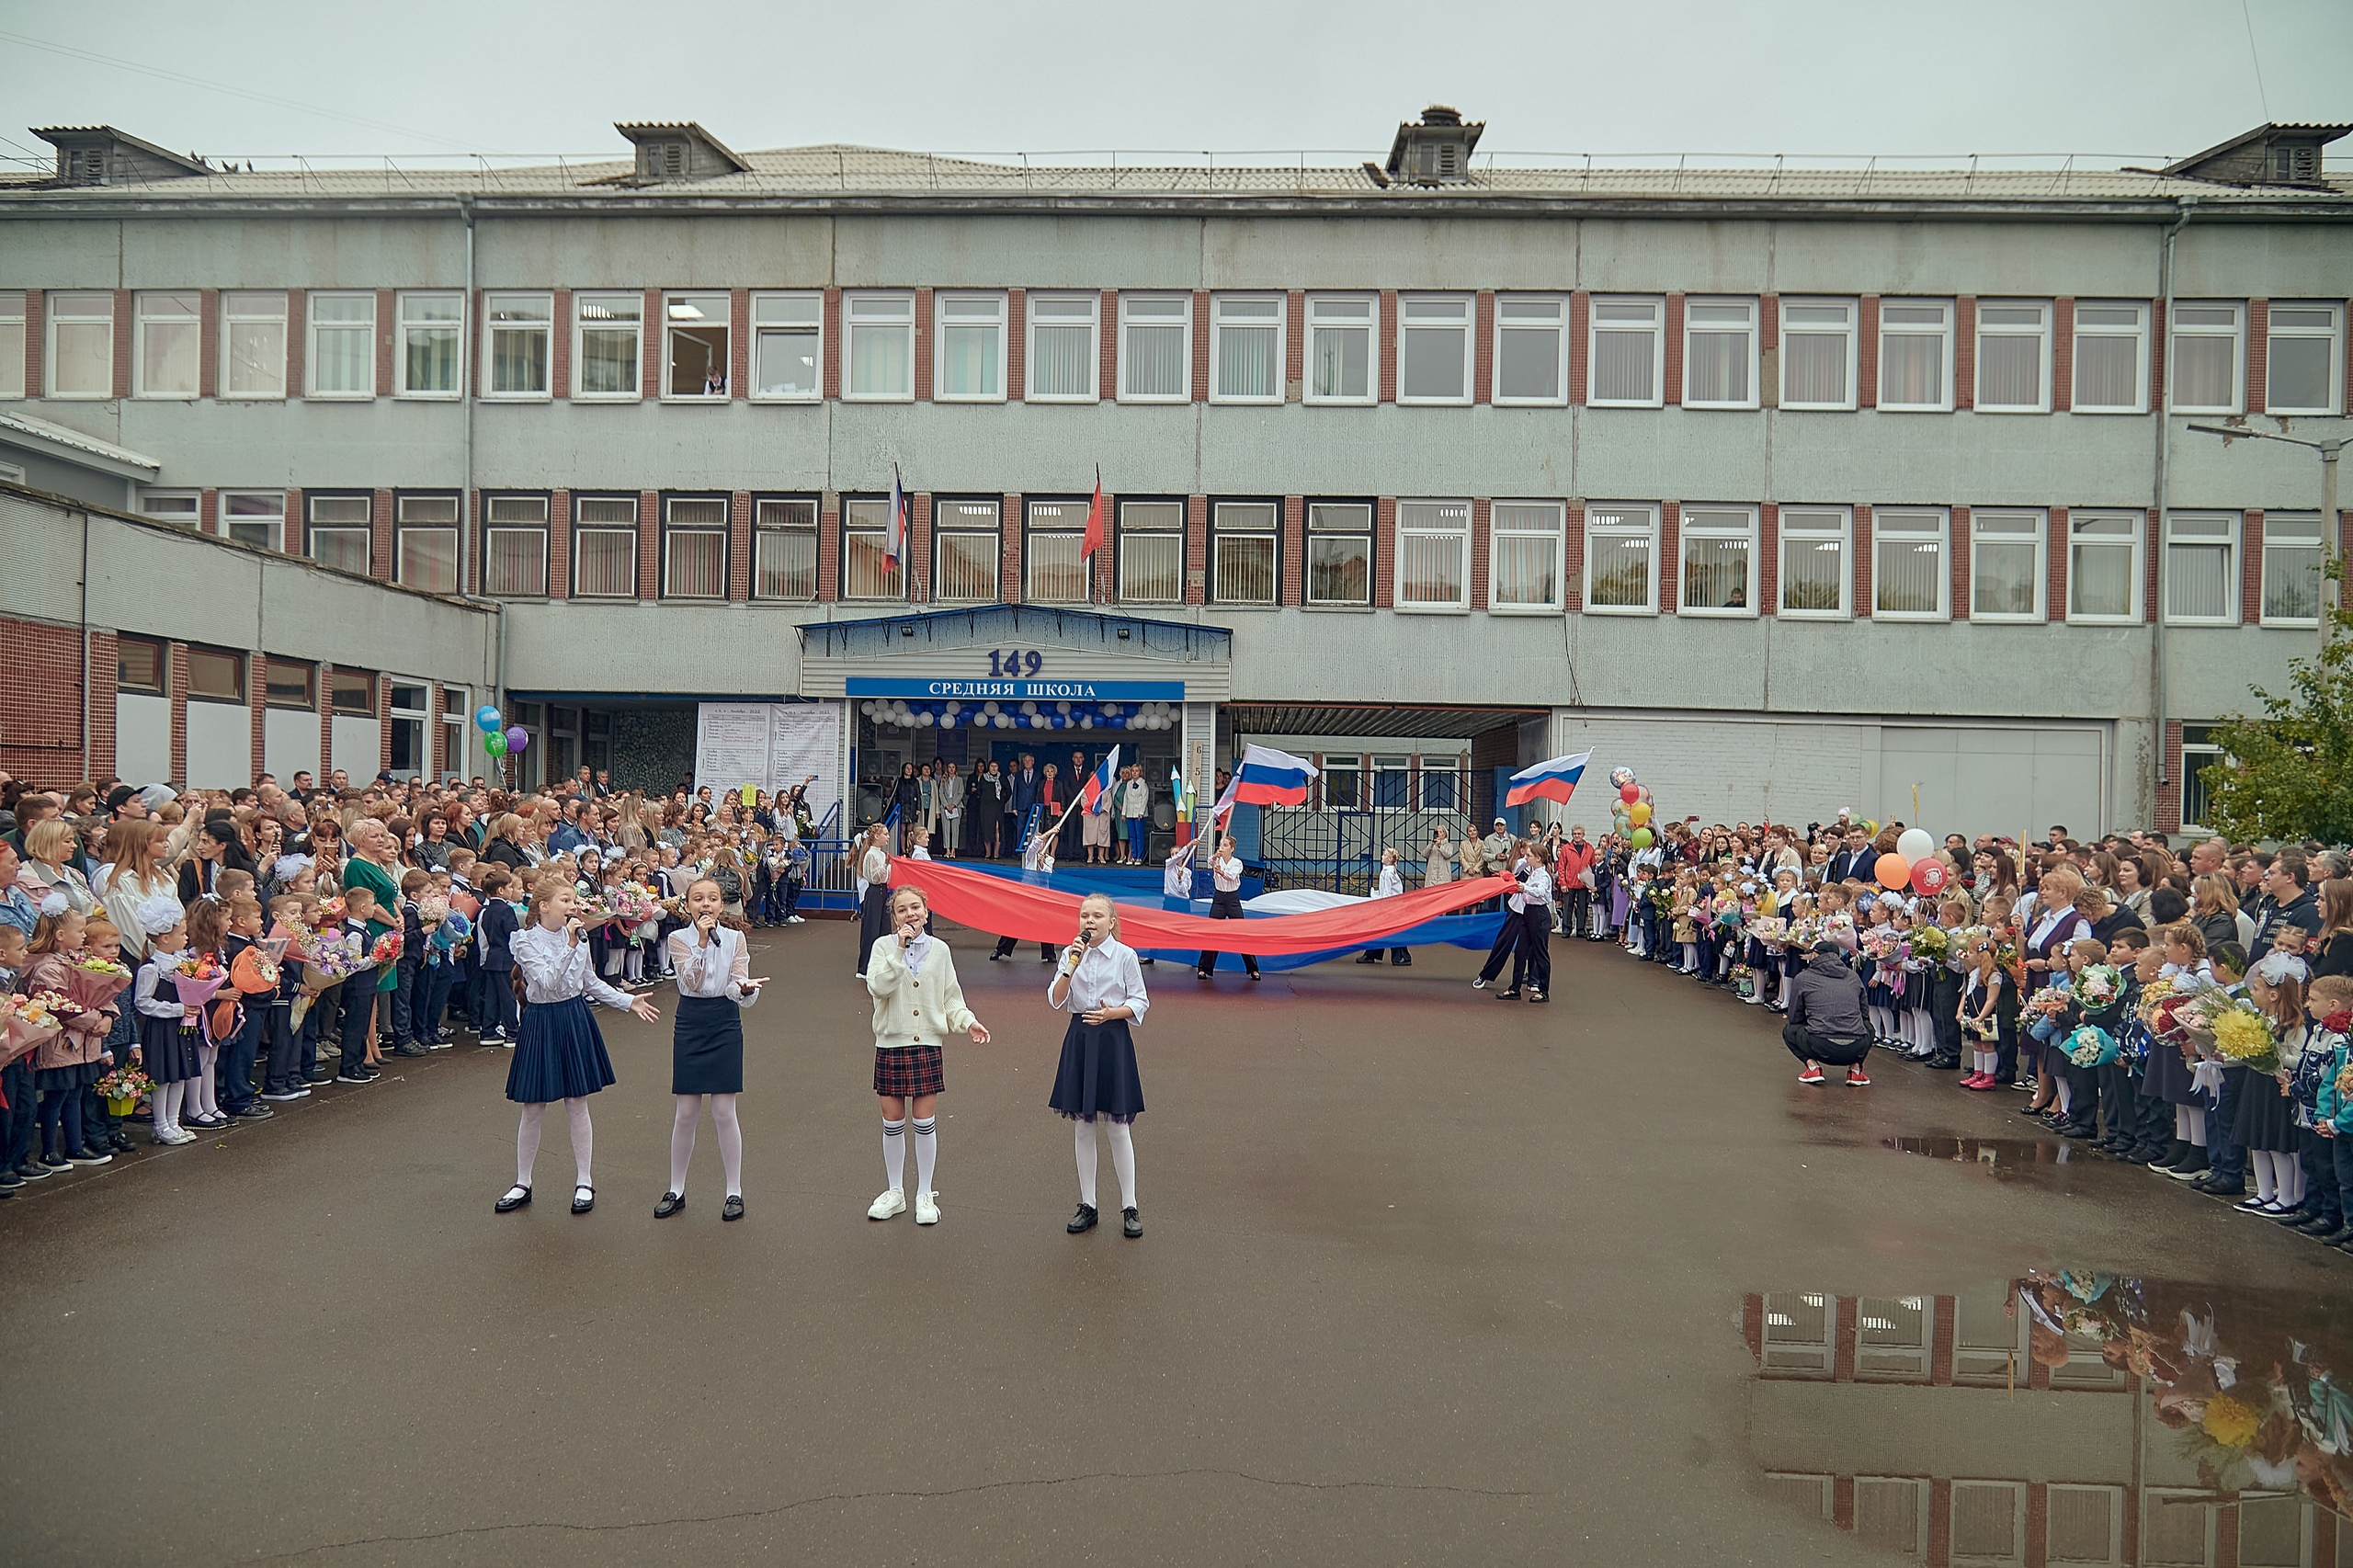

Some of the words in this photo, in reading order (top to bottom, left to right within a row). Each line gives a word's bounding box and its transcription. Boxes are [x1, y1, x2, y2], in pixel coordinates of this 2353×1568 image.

[988, 649, 1042, 677] 149
[928, 682, 1015, 697] СРЕДНЯЯ
[1027, 683, 1096, 697] ШКОЛА
[1195, 767, 1200, 776] 5
